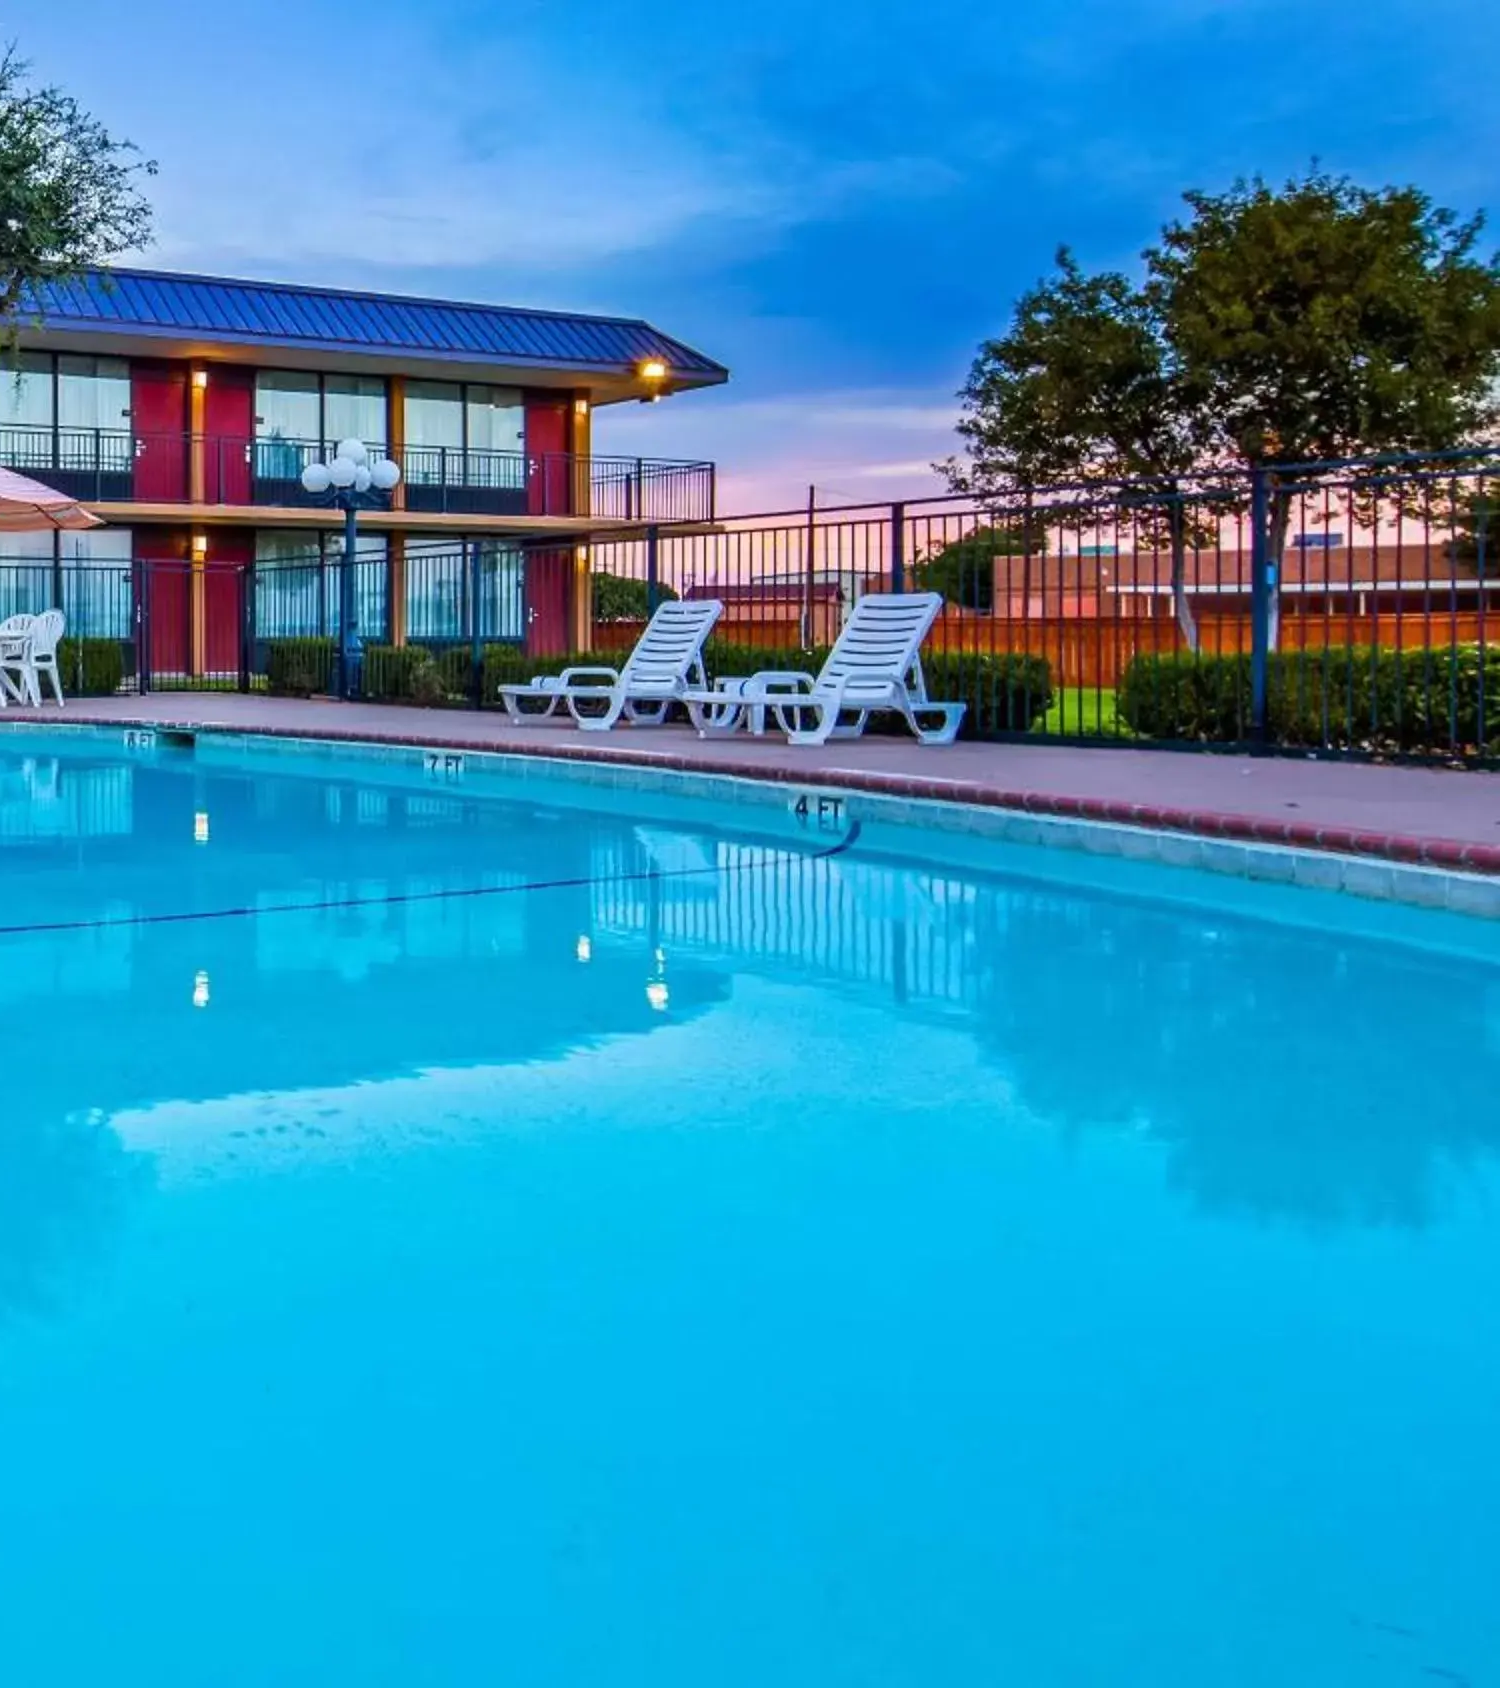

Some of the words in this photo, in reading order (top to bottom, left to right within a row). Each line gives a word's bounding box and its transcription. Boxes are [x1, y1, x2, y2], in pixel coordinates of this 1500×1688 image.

[430, 754, 438, 770] 7
[445, 755, 462, 772] FT
[795, 794, 808, 815] 4
[818, 795, 843, 818] FT
